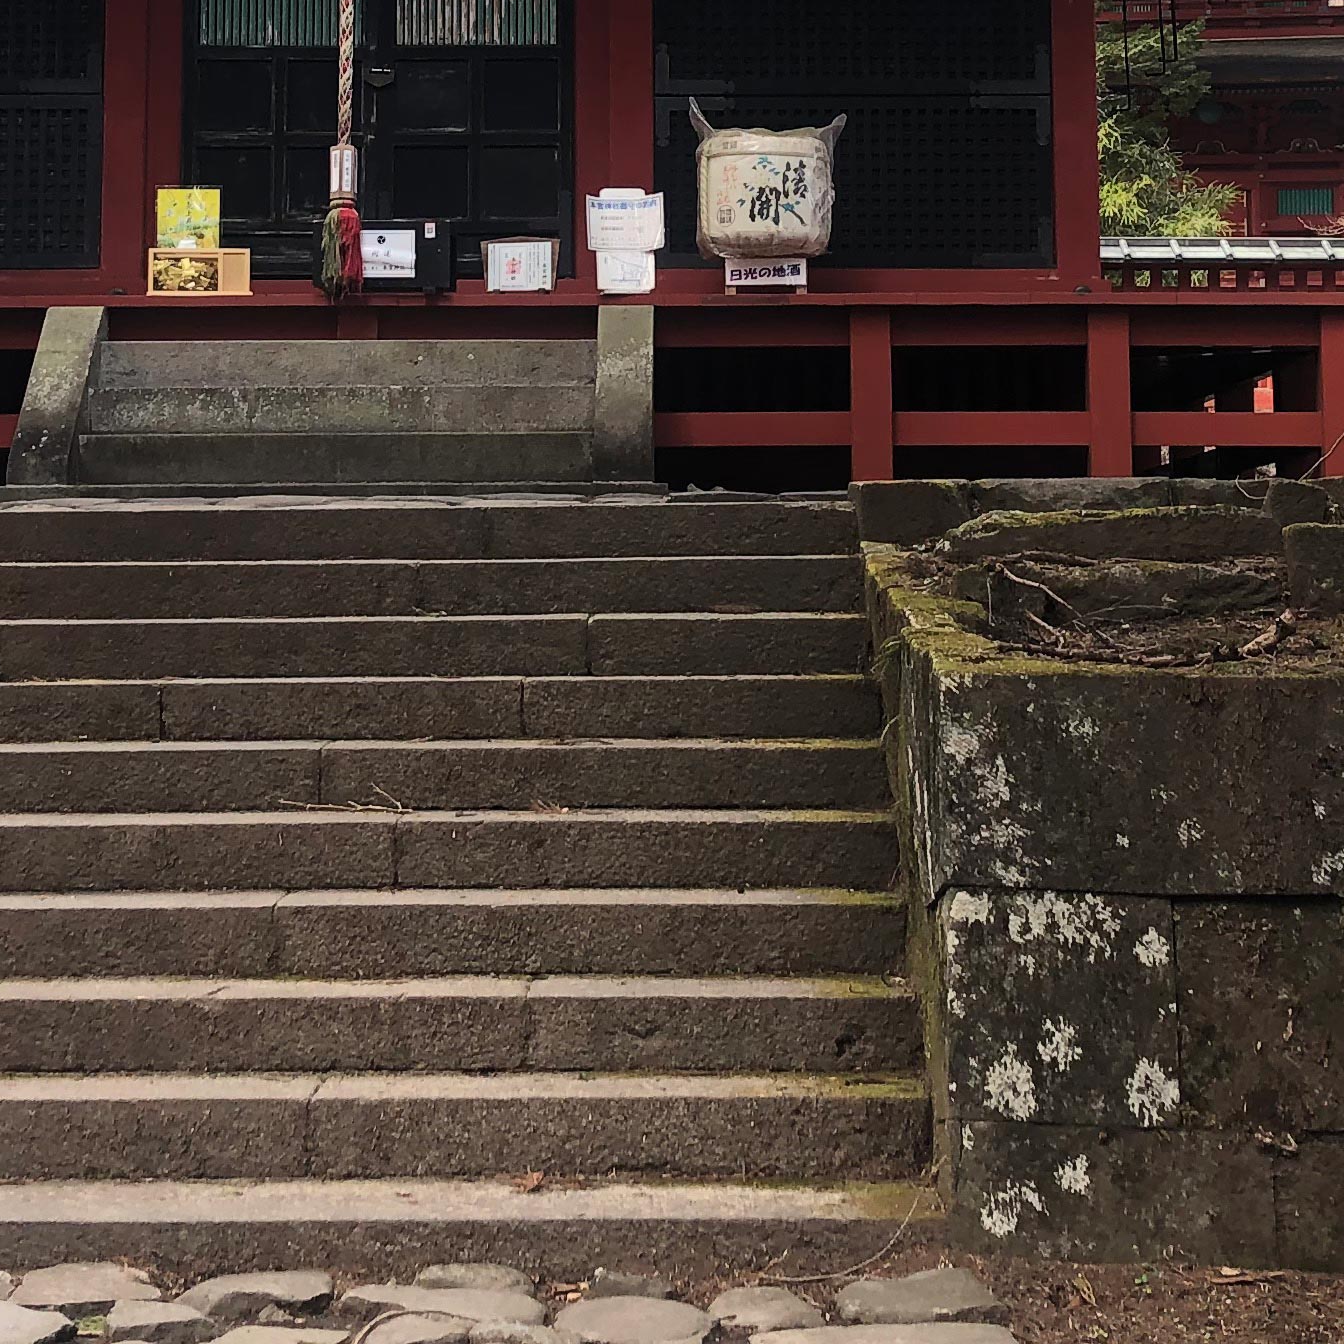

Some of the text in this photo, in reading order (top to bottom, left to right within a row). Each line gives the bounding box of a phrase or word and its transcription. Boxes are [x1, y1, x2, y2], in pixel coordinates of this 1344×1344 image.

[730, 263, 801, 282] 日光の地酒
